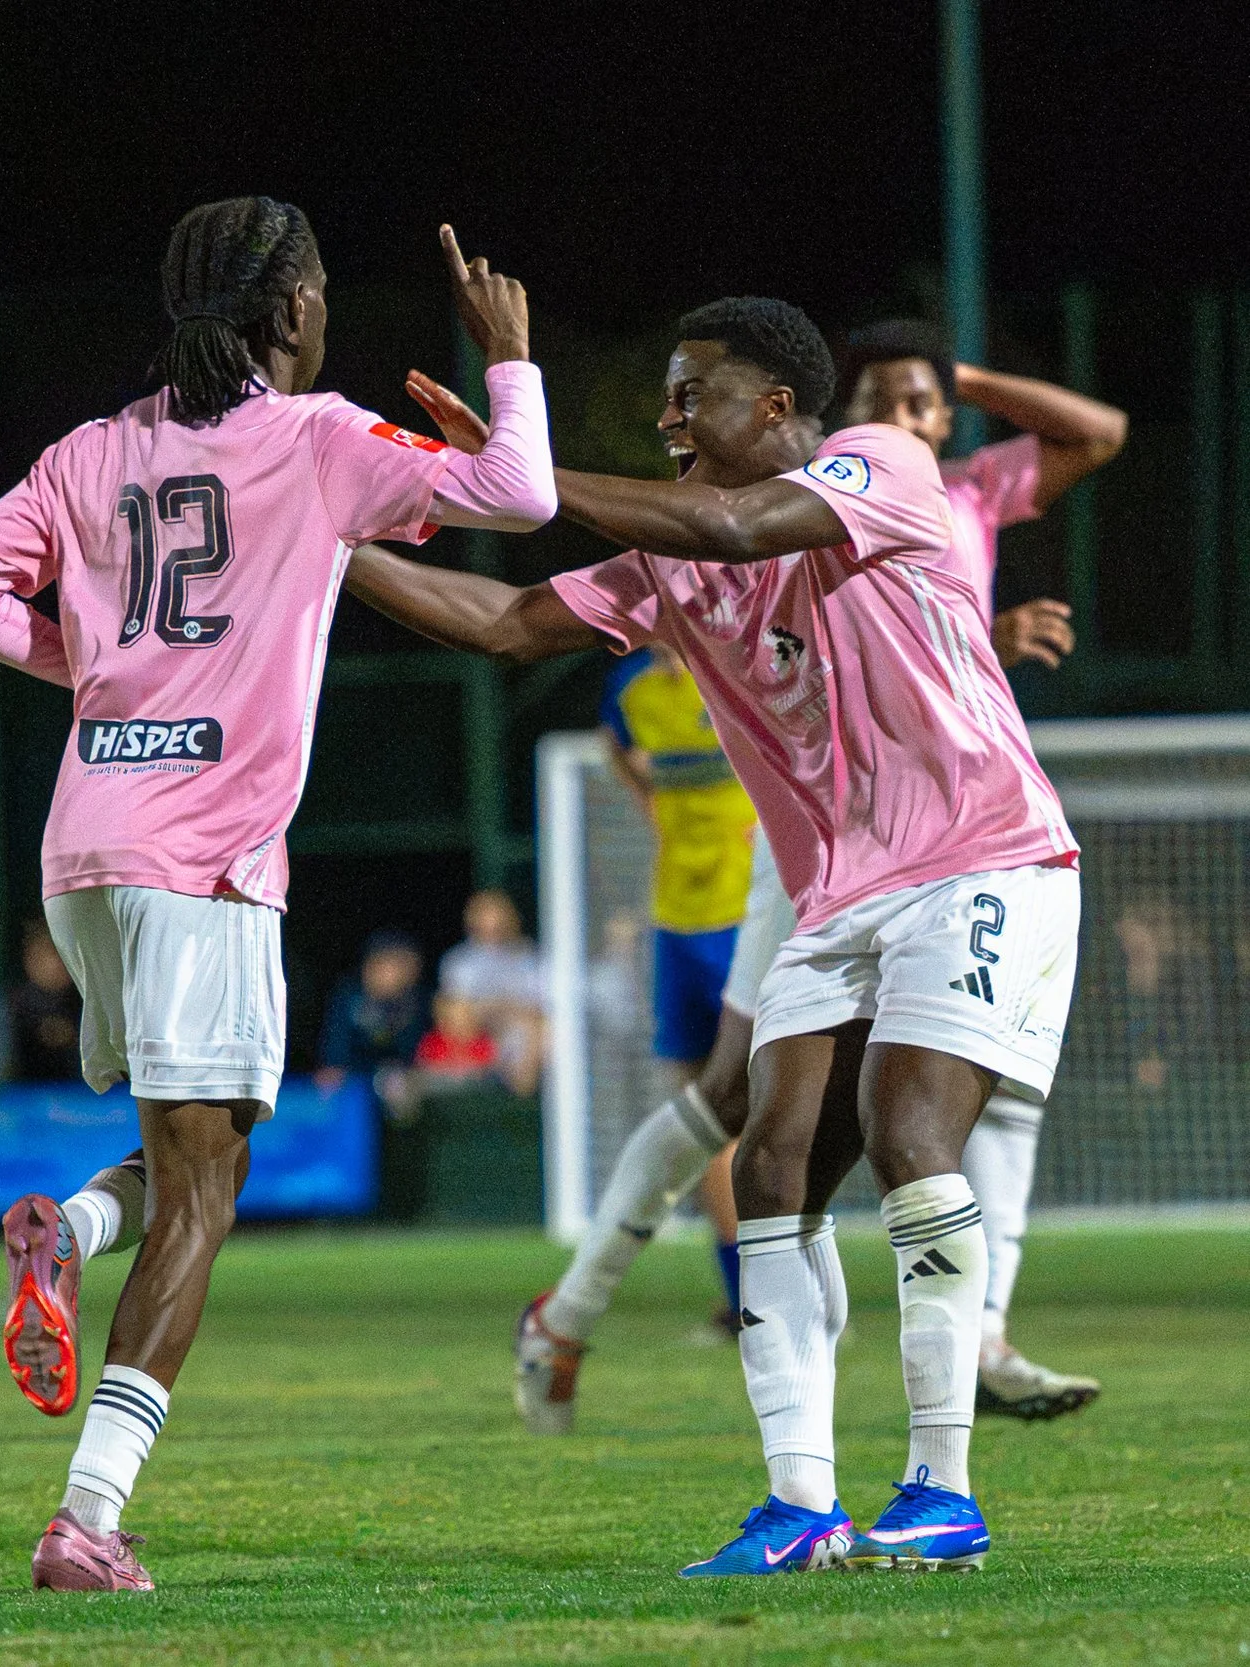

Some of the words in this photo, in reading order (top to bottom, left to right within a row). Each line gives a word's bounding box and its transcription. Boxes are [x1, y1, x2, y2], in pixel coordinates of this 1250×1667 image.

[117, 473, 236, 649] 12
[157, 762, 201, 775] SOLUTIONS
[969, 892, 1006, 965] 2
